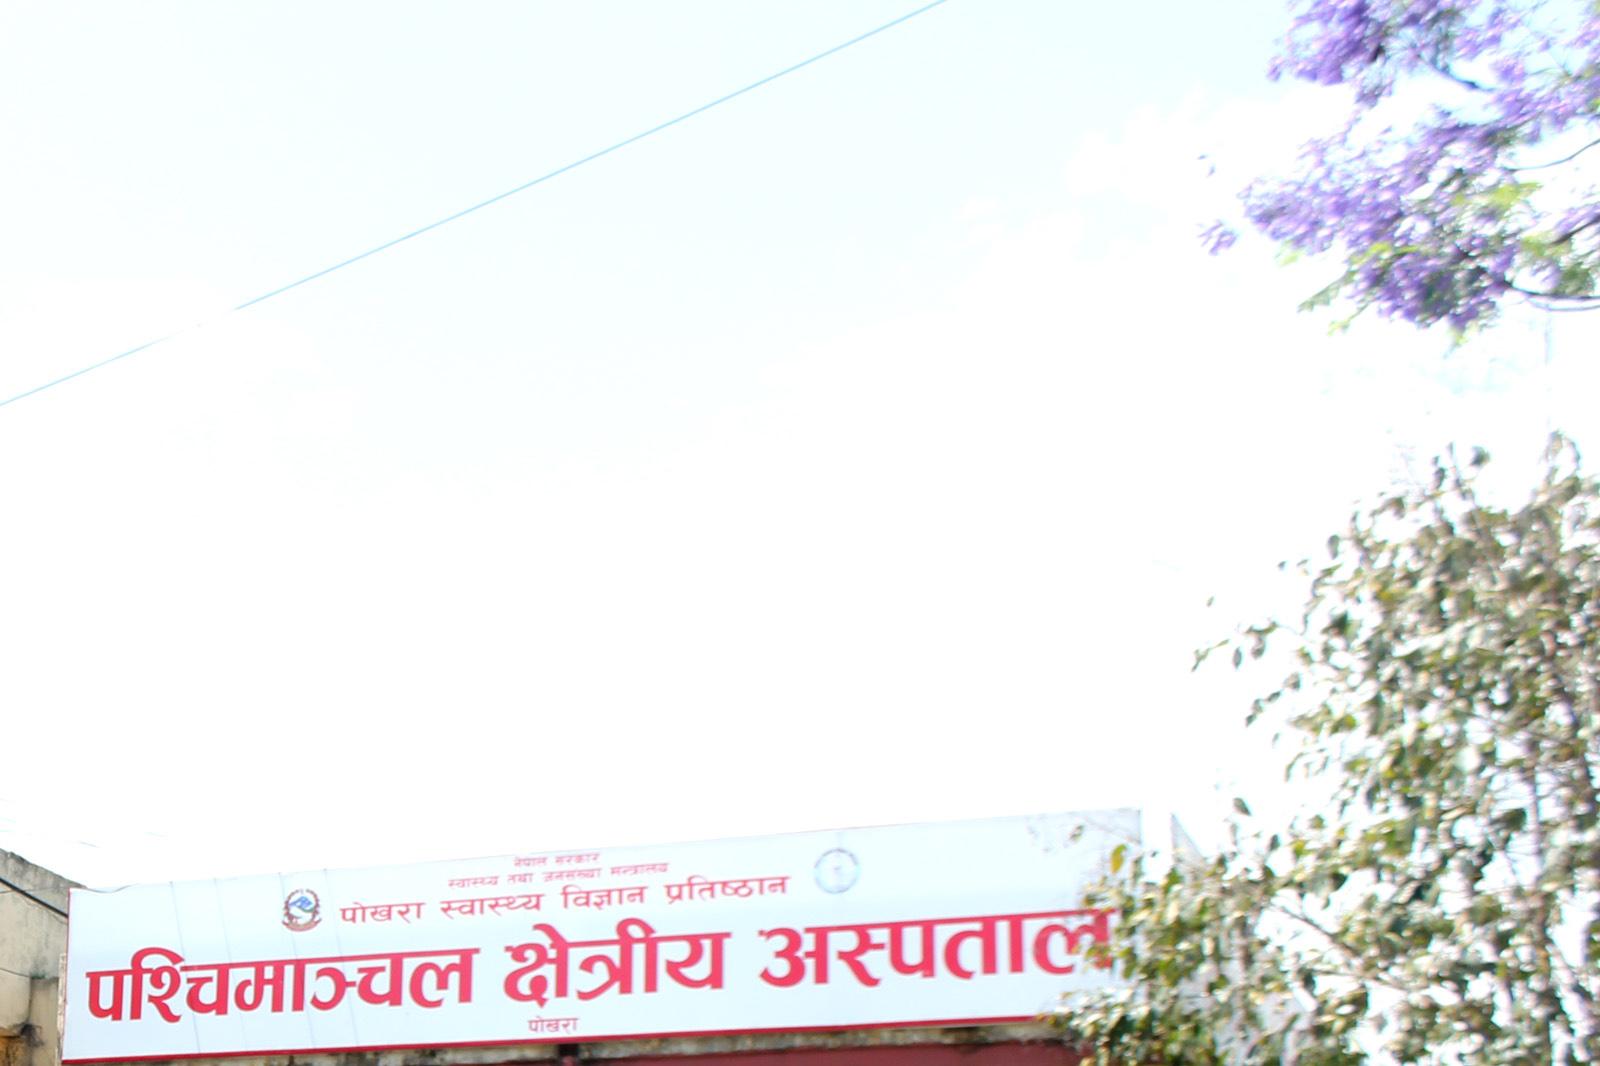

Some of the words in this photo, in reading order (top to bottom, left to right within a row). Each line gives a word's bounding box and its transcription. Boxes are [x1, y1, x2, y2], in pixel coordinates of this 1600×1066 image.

[448, 875, 499, 888] स्वास्थ्य
[507, 872, 533, 883] तथा
[340, 902, 422, 924] पोखरा
[440, 893, 545, 920] स्वास्थ्य
[561, 884, 647, 911] विज्ञान
[664, 875, 790, 905] प्रतिष्ठान
[85, 946, 480, 1024] पश्चिमाञ्चल
[502, 917, 731, 1008] क्षेत्रीय
[757, 908, 1116, 988] अस्पताल
[527, 1017, 578, 1034] पोखरा
